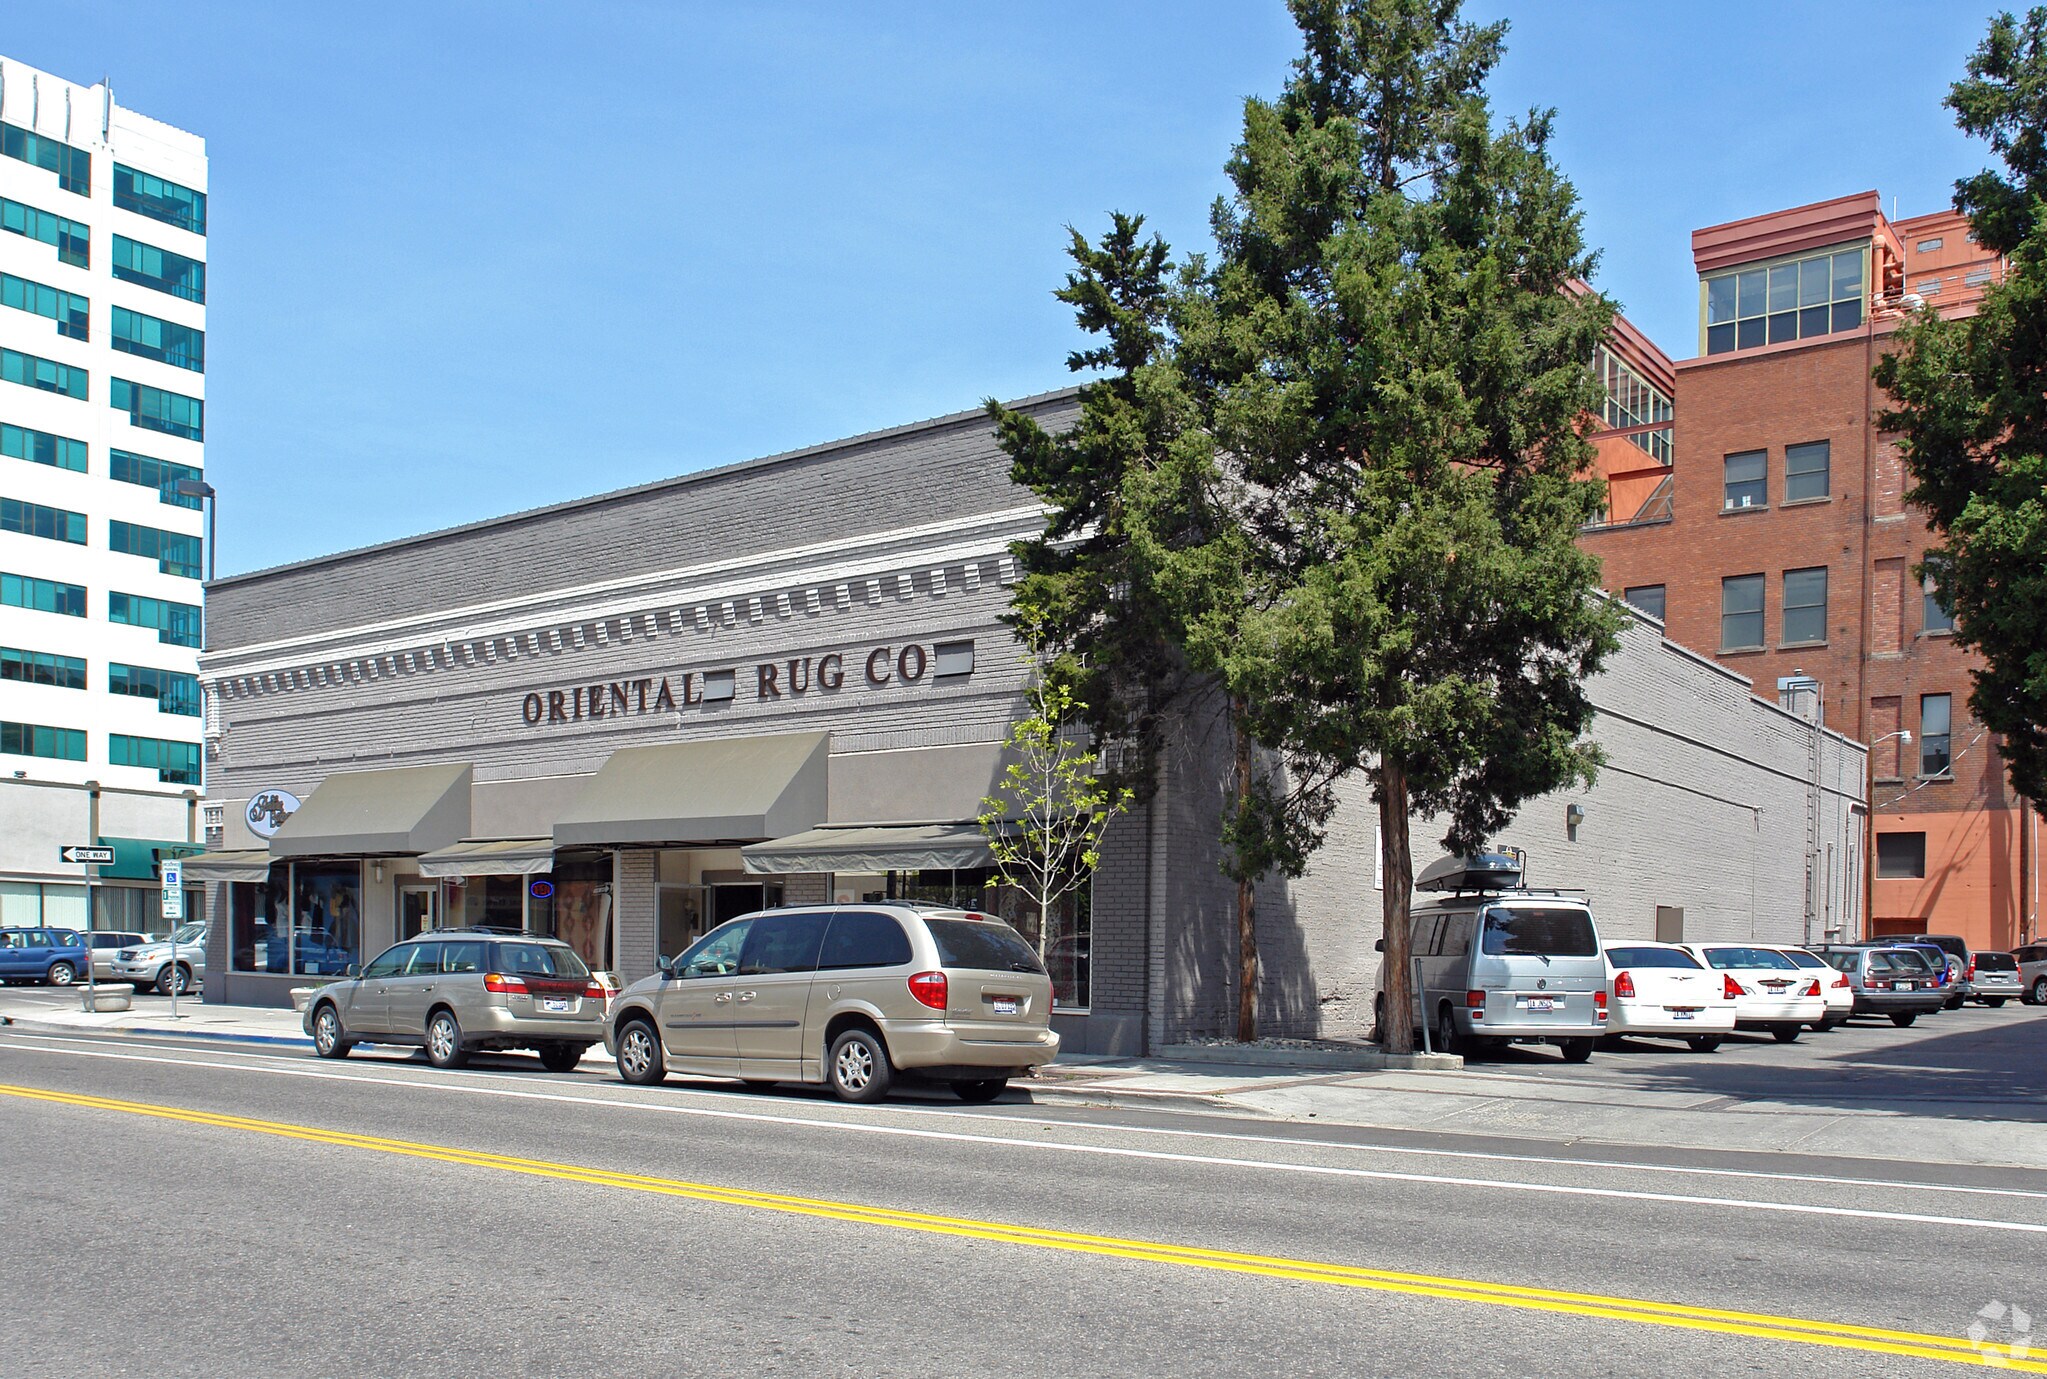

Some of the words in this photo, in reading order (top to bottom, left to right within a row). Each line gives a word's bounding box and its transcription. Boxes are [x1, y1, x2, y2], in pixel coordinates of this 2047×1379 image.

[523, 674, 702, 723] ORIENTAL
[757, 653, 844, 698] RUG
[866, 644, 927, 684] CO
[75, 851, 91, 859] ONE
